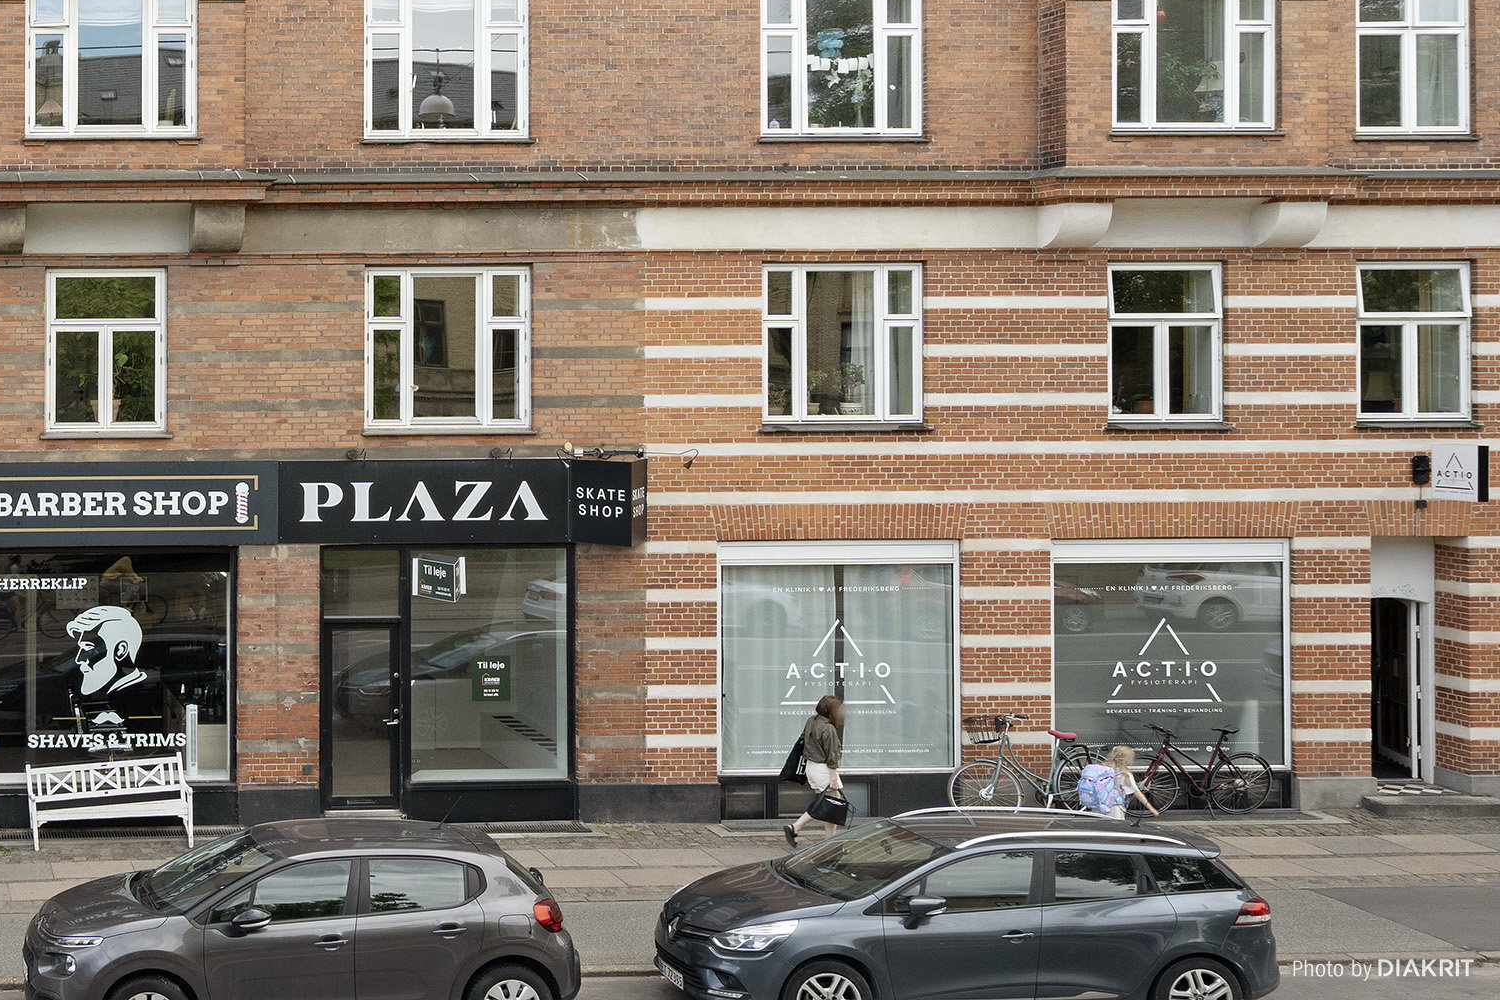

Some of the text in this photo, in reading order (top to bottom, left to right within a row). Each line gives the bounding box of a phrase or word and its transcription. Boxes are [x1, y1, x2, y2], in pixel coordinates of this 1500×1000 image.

[299, 480, 549, 522] PLAZA
[576, 486, 626, 501] SKATE
[133, 490, 229, 516] SHOP
[578, 503, 624, 518] SHOP
[423, 564, 447, 579] Til leje
[477, 661, 488, 669] Til
[27, 732, 188, 749] SHAVES & TRIMS
